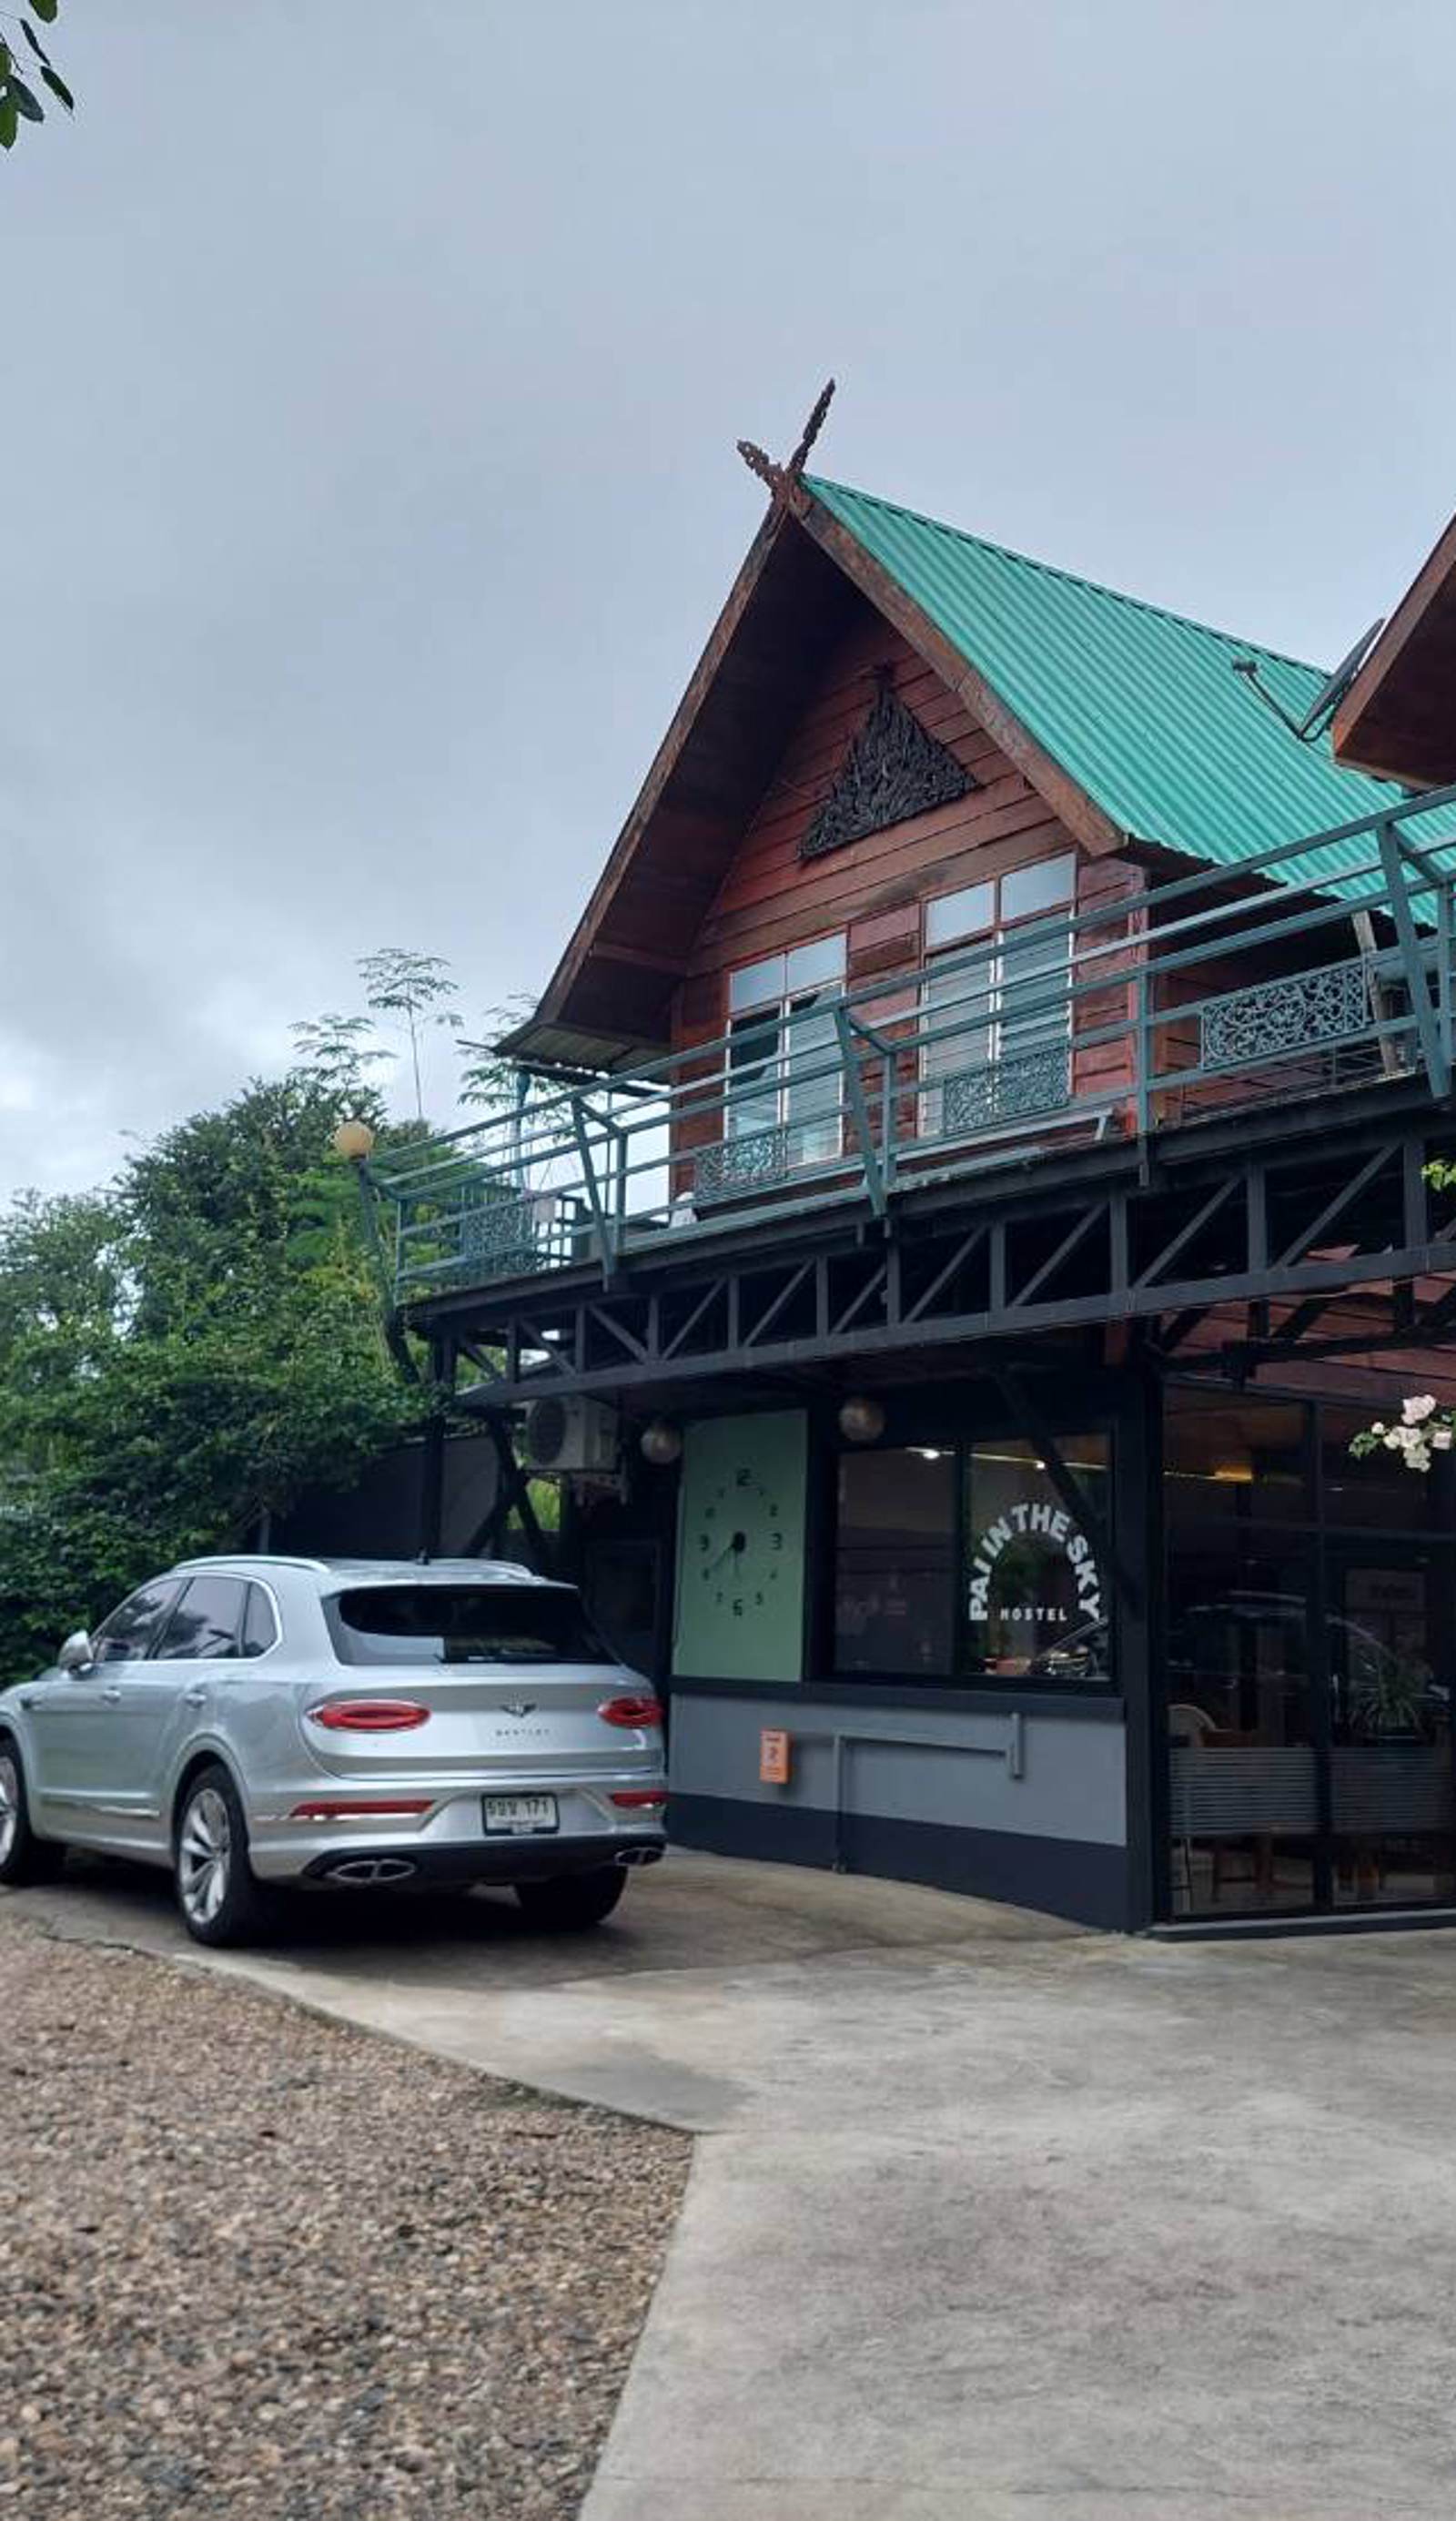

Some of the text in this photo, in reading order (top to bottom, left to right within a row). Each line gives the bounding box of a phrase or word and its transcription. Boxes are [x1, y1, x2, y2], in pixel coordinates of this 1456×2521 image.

[771, 1532, 784, 1551] 3
[969, 1503, 1101, 1621] PAI IN THE SKY
[1000, 1607, 1067, 1622] HOSTEL
